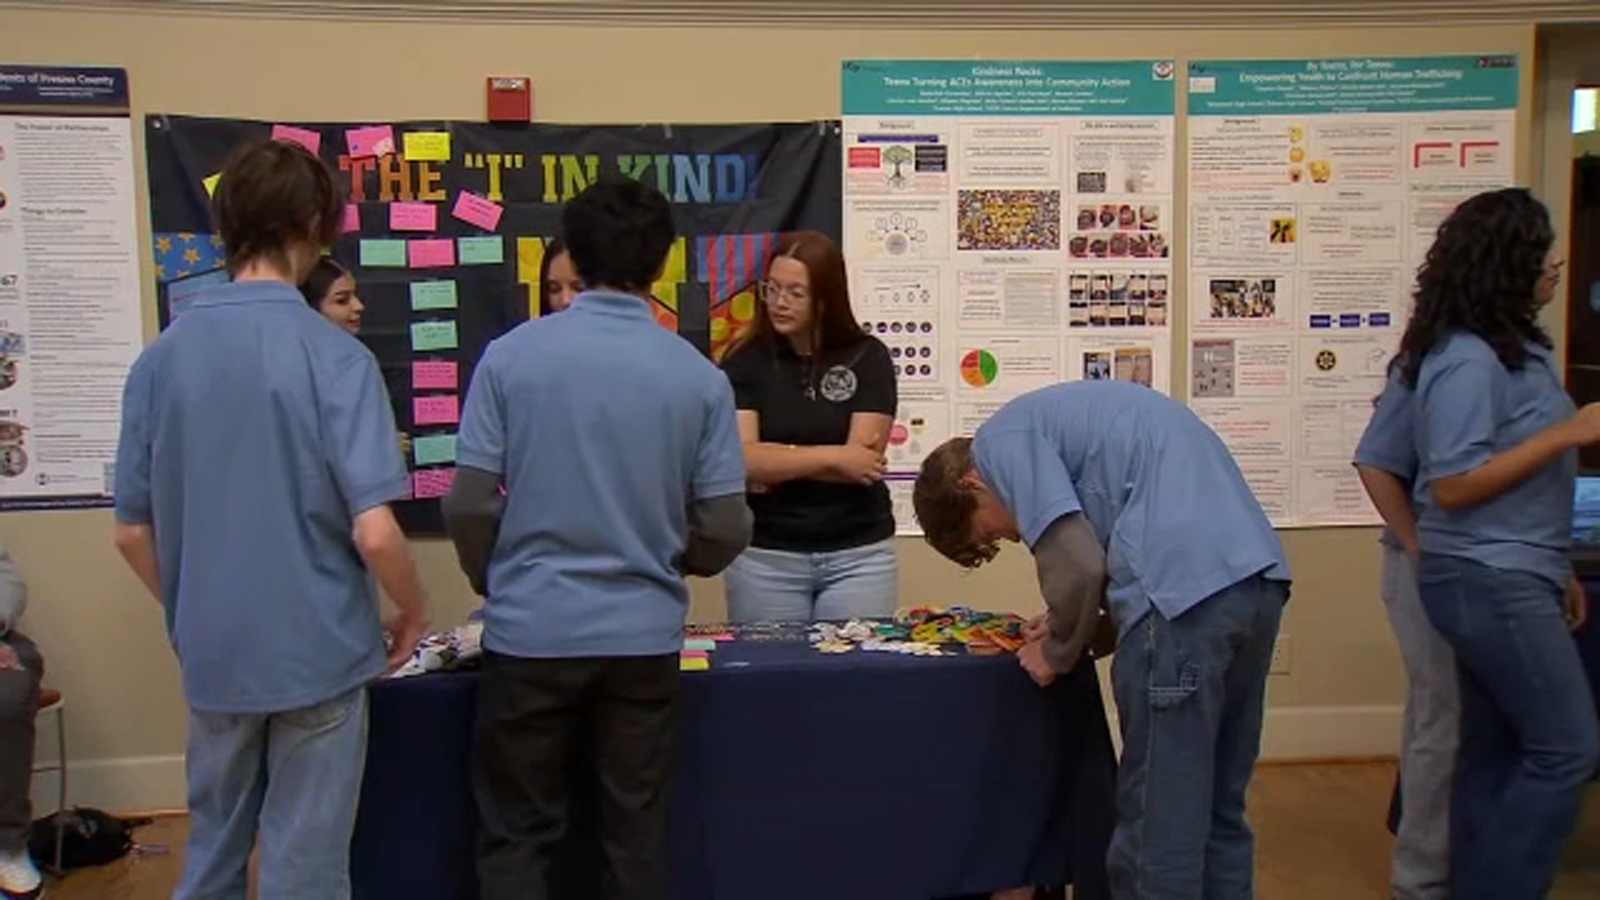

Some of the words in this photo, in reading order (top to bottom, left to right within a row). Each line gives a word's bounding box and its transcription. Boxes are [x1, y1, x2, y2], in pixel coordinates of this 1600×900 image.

[77, 74, 115, 87] County
[1380, 69, 1413, 80] Human
[911, 76, 948, 89] Turning
[1046, 77, 1099, 89] Community
[1100, 78, 1131, 88] Action
[339, 154, 447, 201] THE
[464, 153, 523, 201] "I"
[542, 154, 600, 203] IN
